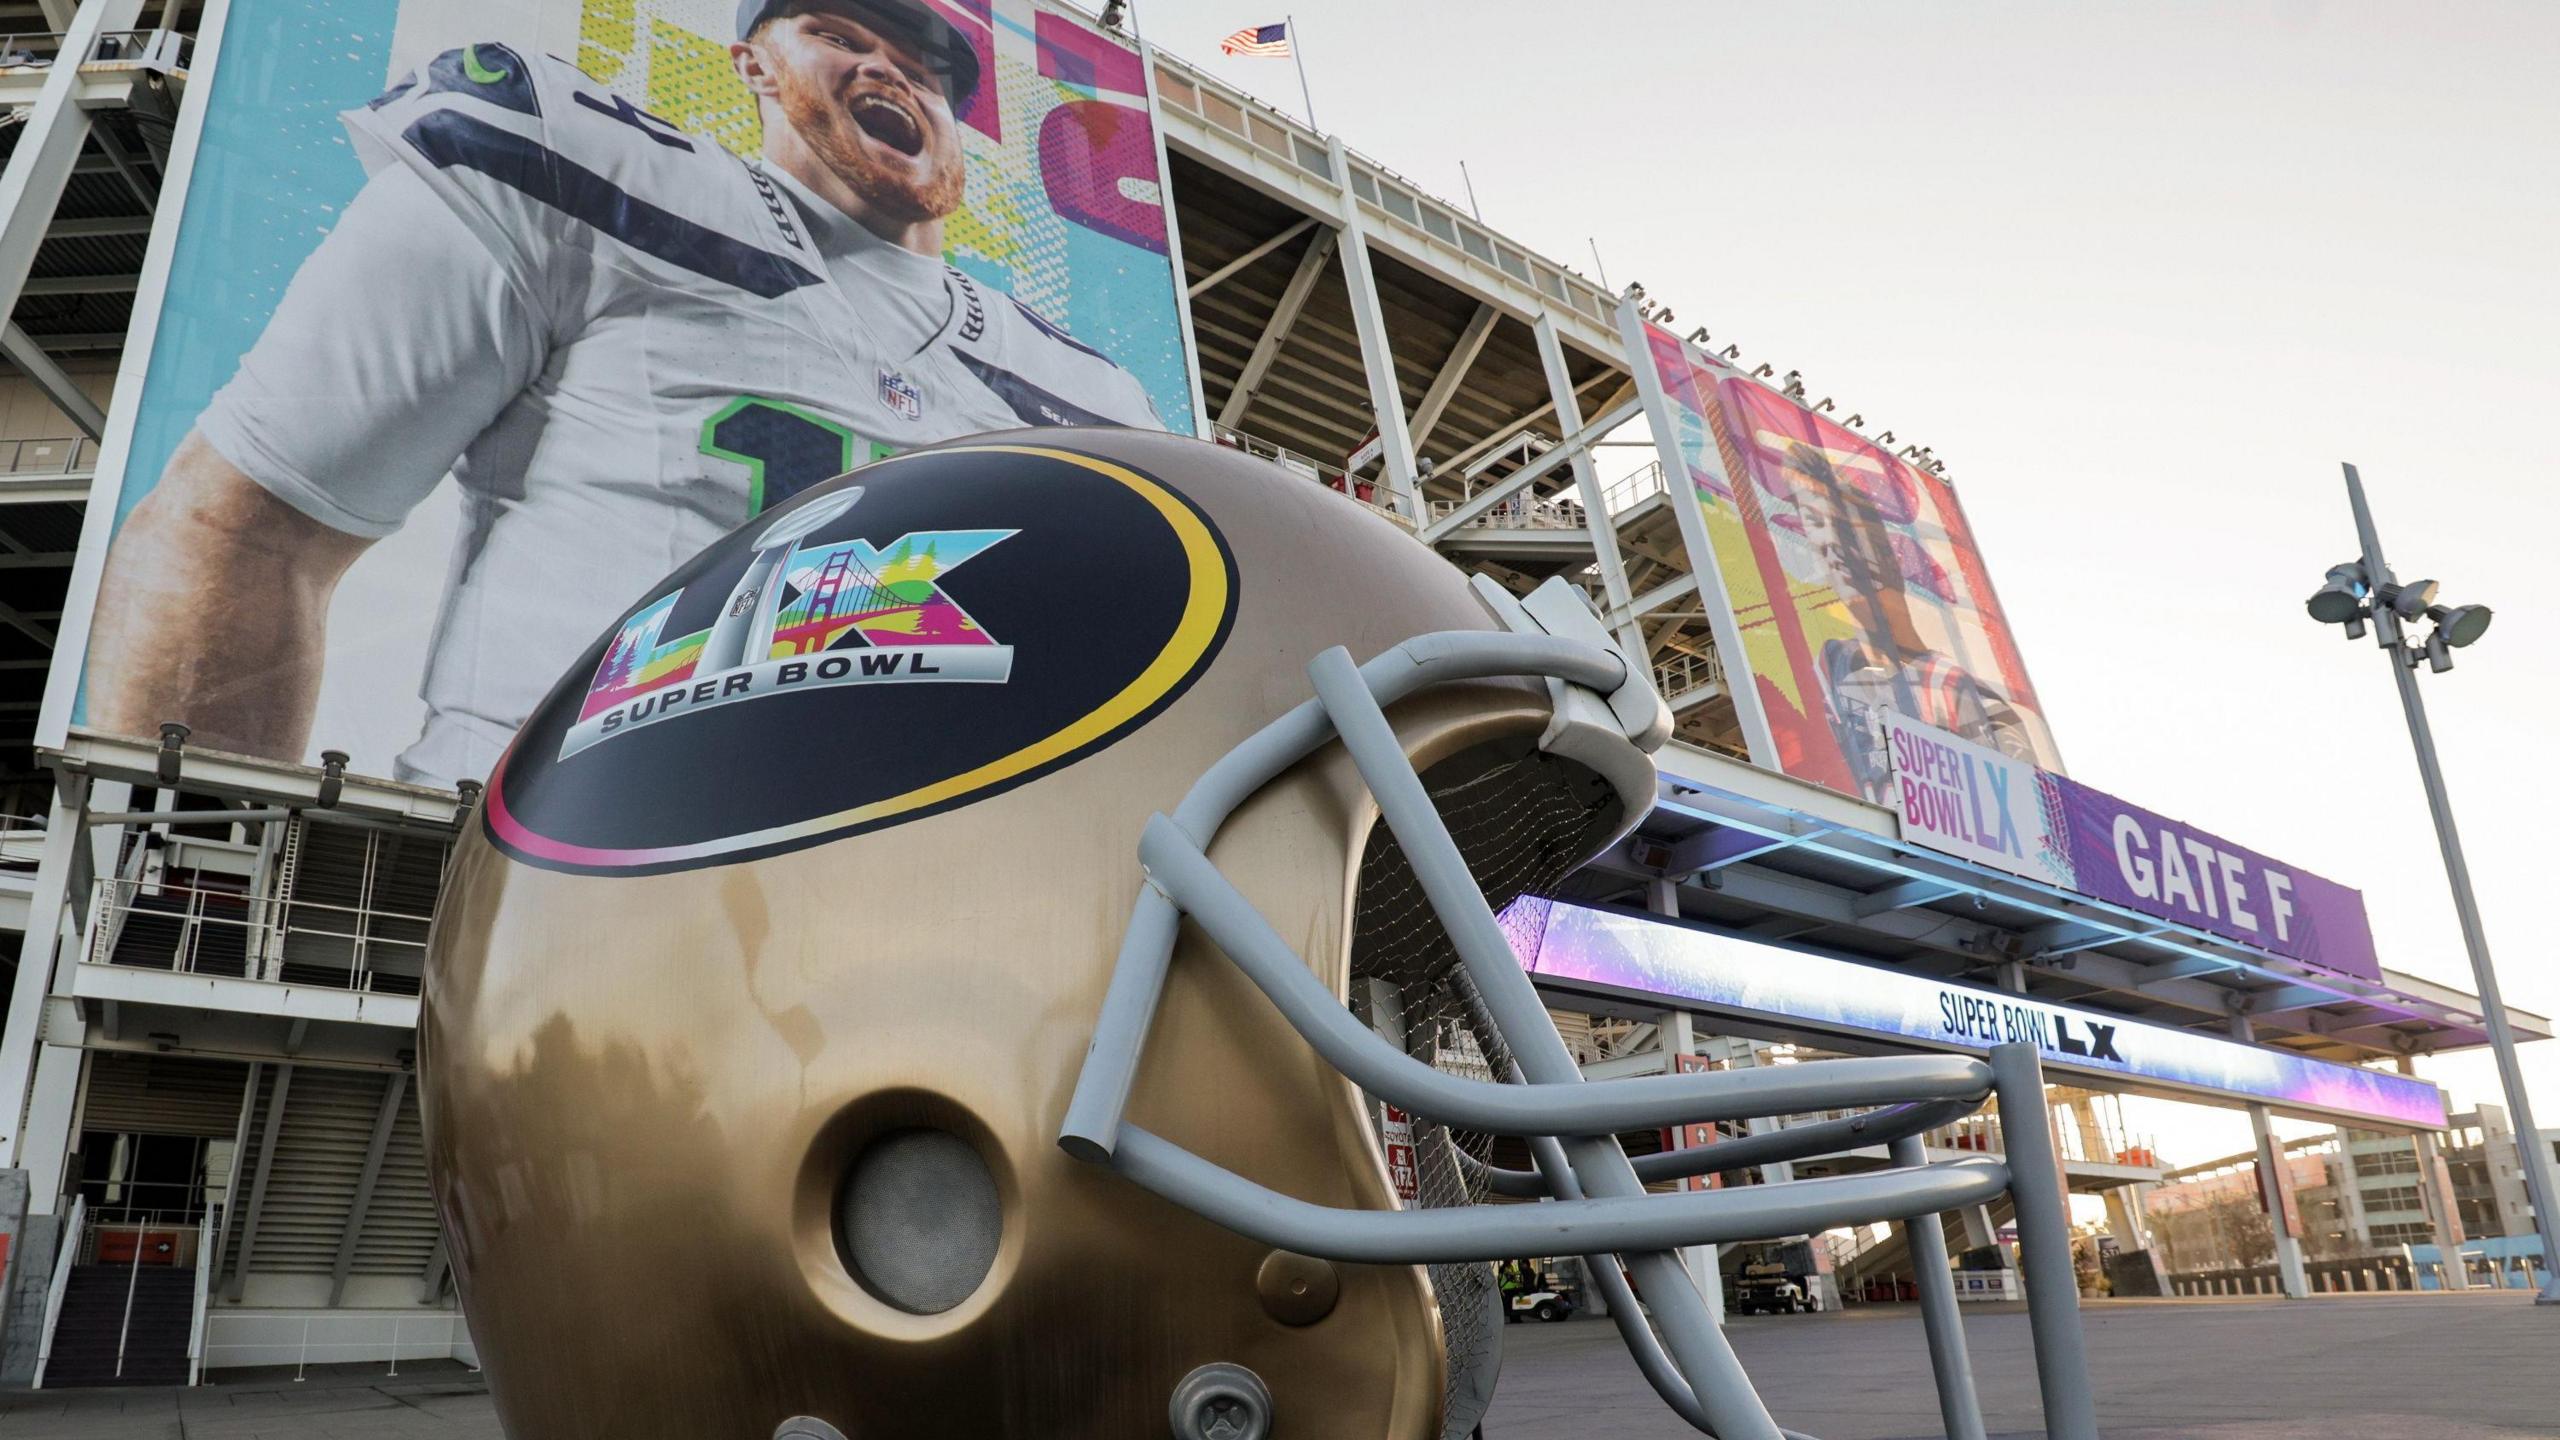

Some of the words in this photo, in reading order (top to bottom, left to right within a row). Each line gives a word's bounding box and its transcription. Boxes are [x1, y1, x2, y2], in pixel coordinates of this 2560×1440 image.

[885, 387, 917, 414] NFL
[600, 671, 753, 734] SUPER
[776, 652, 940, 686] BOWL
[1893, 726, 1964, 792] SUPER
[1901, 775, 1973, 843] BOWL
[1962, 752, 2024, 860] LX
[2112, 813, 2259, 932] GATE
[2263, 868, 2294, 942] F
[1939, 990, 2002, 1042] SUPER
[2002, 1003, 2055, 1052] BOWL
[2053, 1013, 2125, 1063] LX
